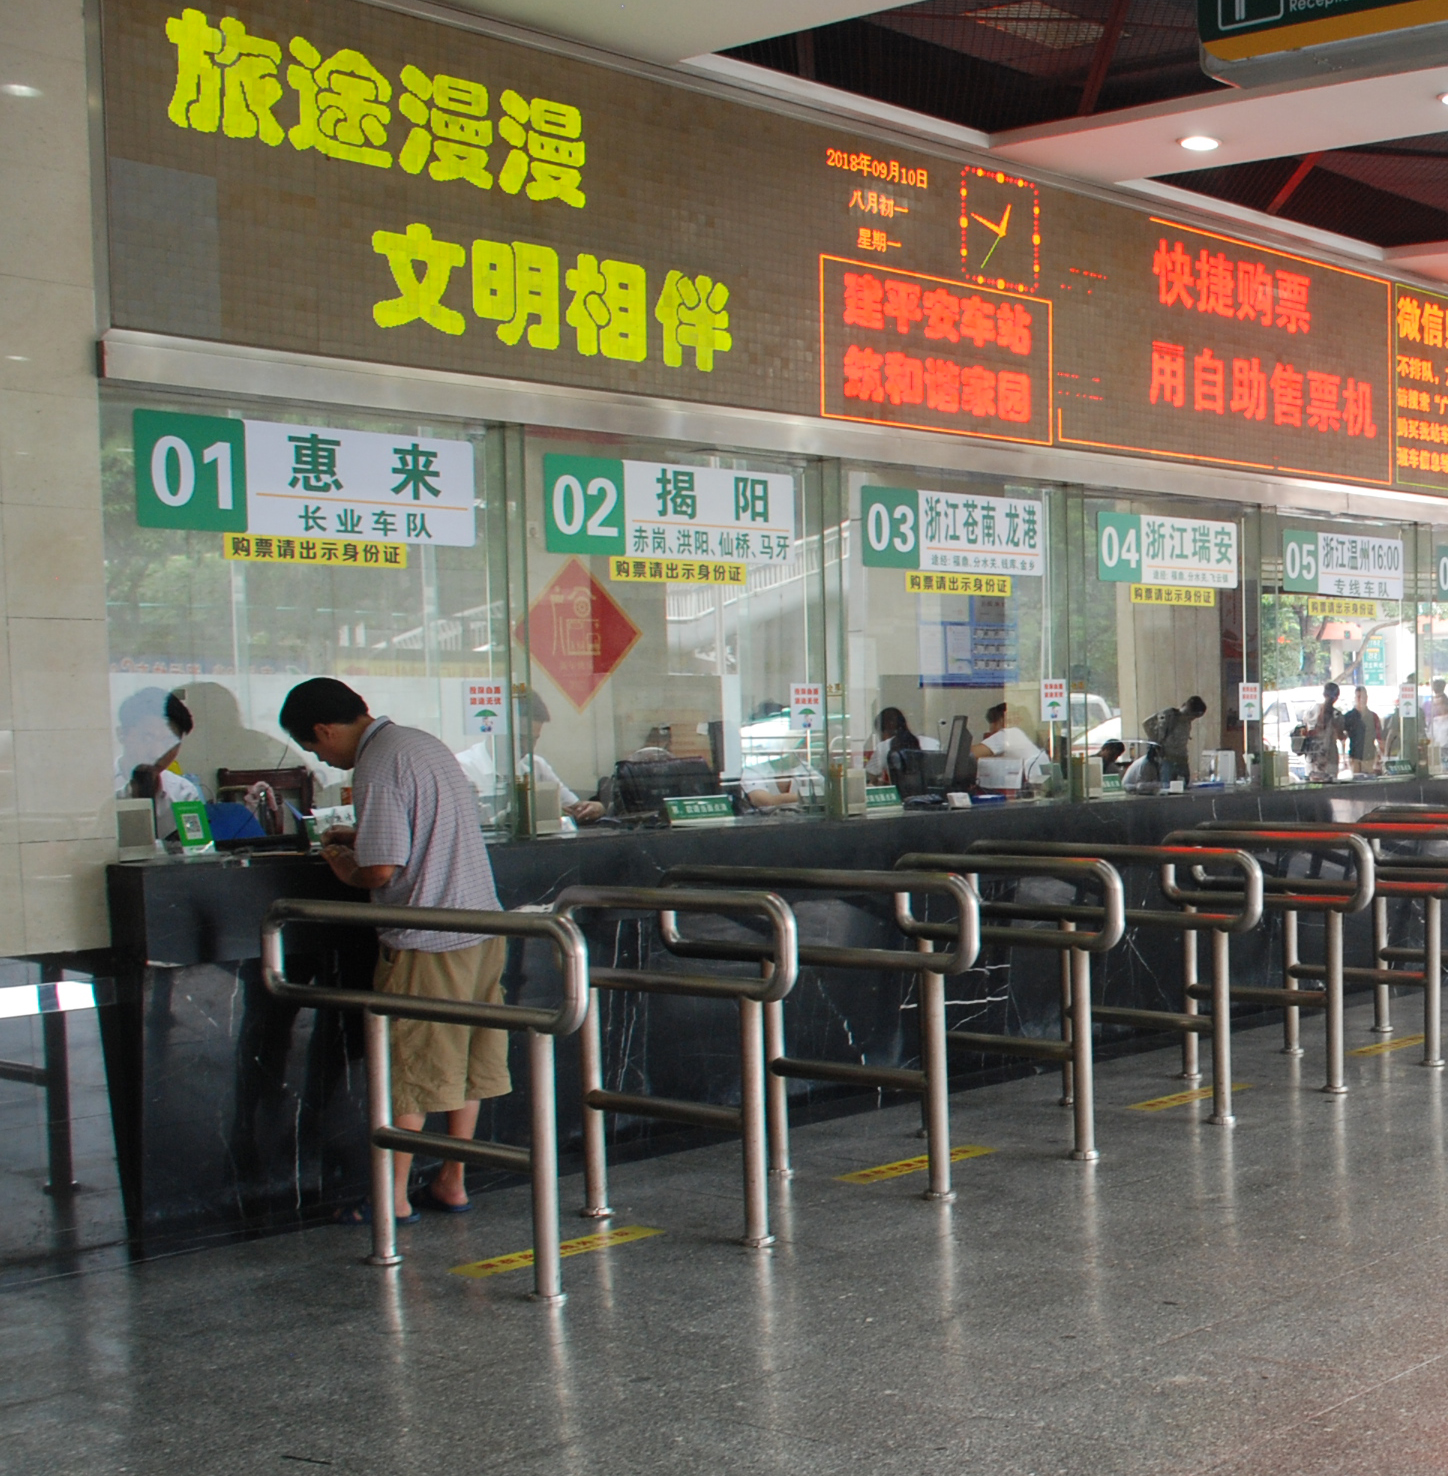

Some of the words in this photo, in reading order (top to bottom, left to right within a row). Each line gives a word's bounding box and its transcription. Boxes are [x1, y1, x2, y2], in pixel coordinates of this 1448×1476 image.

[165, 8, 587, 209] 旅途漫漫
[826, 148, 929, 190] 2018年09月10日
[849, 190, 910, 218] 八月初一
[857, 227, 902, 253] 星期一
[371, 222, 733, 373] 文明相伴
[1152, 238, 1312, 334] 快捷购票
[843, 272, 1033, 356] 建平安车站
[1149, 340, 1378, 439] 用自助售票机
[149, 435, 236, 511] 01
[288, 433, 441, 501] 惠来
[552, 474, 619, 538] 02
[655, 468, 770, 524] 揭阳
[298, 503, 433, 540] 长业车队
[632, 525, 790, 561] 赤岗、洪阳、仙桥、马牙
[867, 502, 916, 554] 03
[925, 496, 1038, 551] 浙江苍南、龙港
[1145, 520, 1234, 566] 浙江瑞安
[230, 534, 403, 568] 购票请出示身份证
[1100, 524, 1140, 570] 04
[1285, 542, 1317, 581] 05
[1321, 535, 1400, 573] 浙江温州16:00
[615, 559, 744, 584] 购票请出示身份证
[908, 573, 1011, 595] 购票请出示身份证
[1333, 576, 1391, 598] 专线车队
[1133, 586, 1212, 605] 购票请出示身份证
[1309, 600, 1376, 617] 购票请出示身份证
